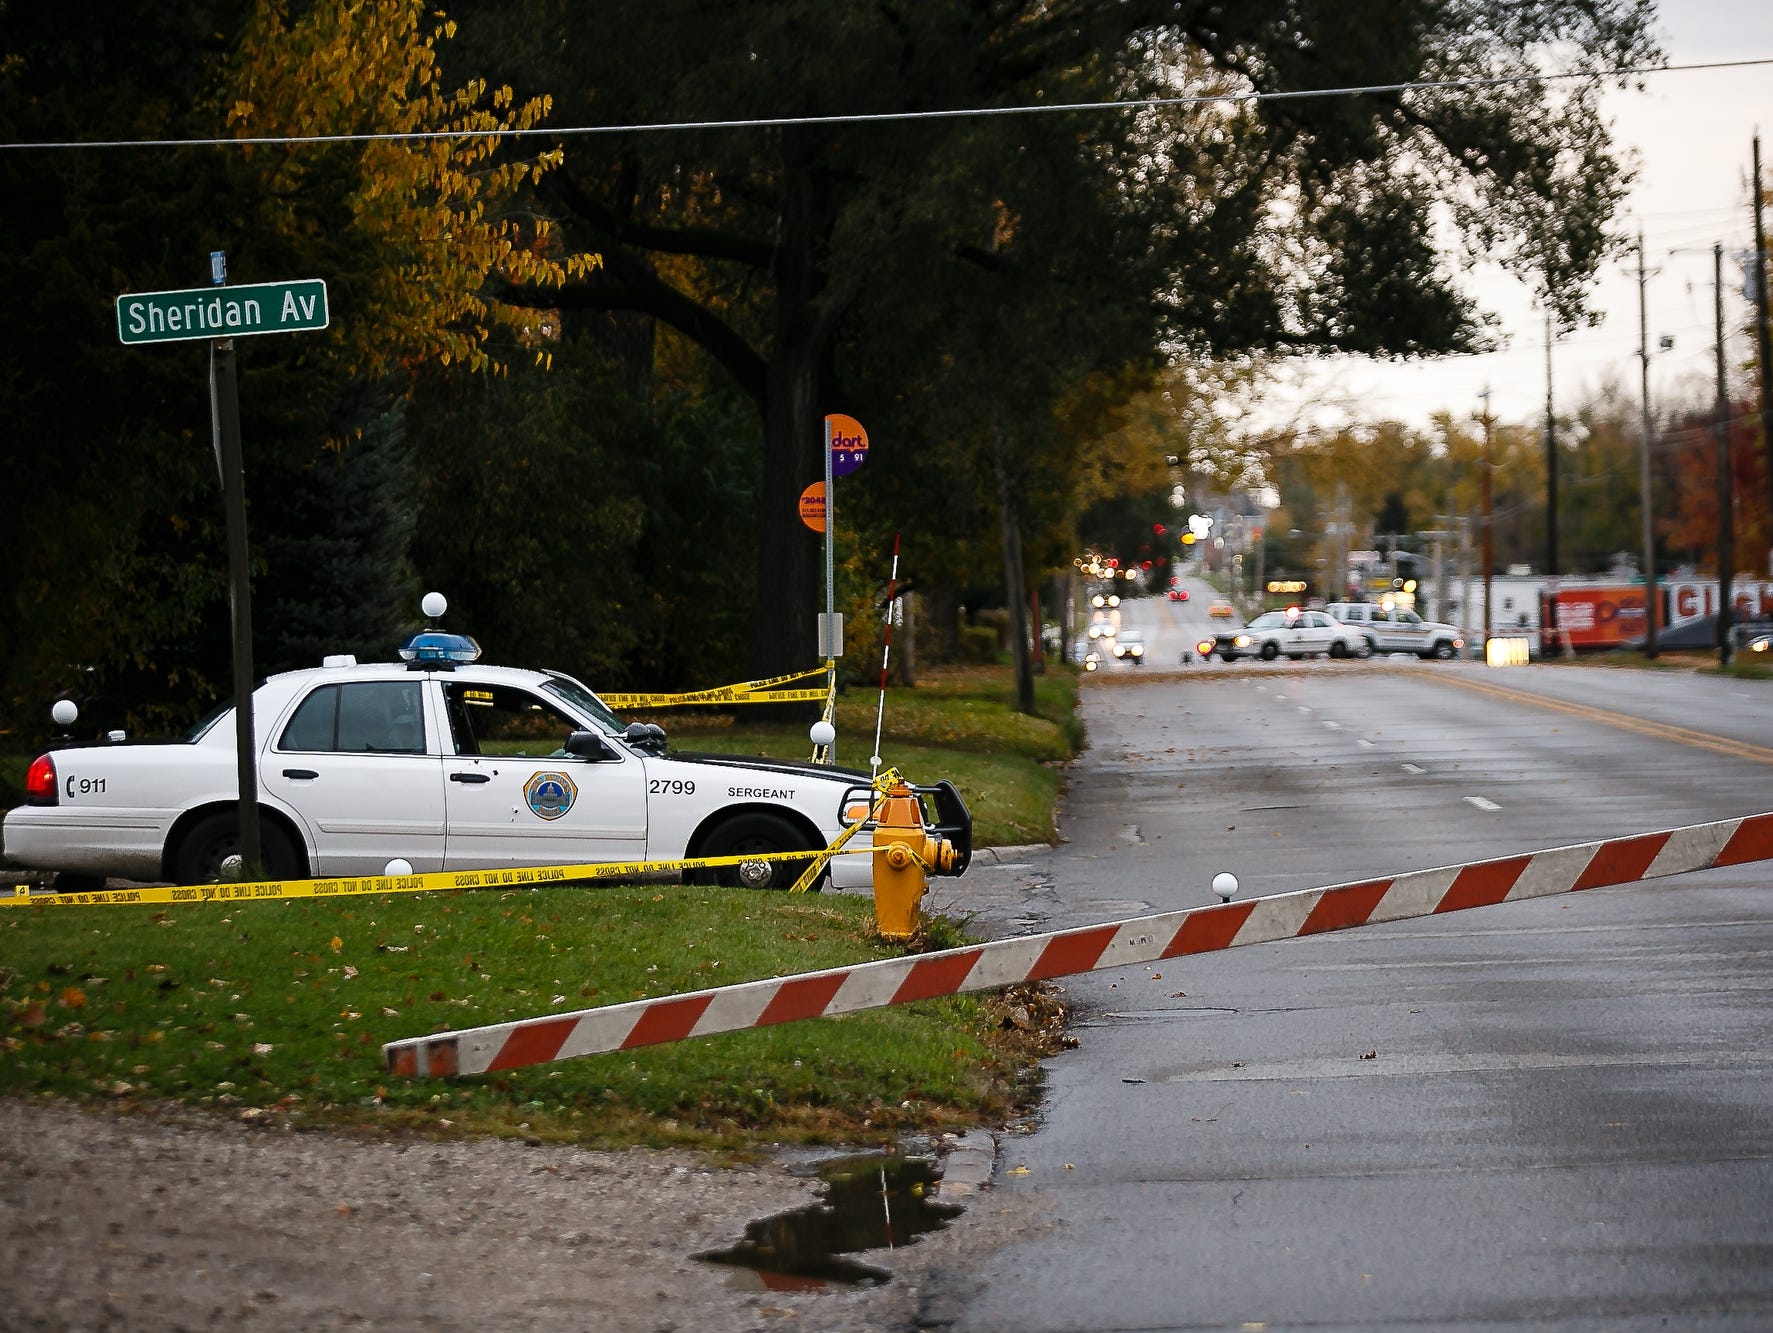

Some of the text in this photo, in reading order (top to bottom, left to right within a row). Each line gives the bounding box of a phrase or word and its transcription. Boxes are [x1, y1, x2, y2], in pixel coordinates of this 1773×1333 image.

[129, 290, 316, 333] Sheridan Av
[840, 453, 863, 461] 5 91
[80, 778, 106, 793] 911
[649, 779, 695, 795] 2799
[728, 787, 796, 799] SERGEANT
[19, 886, 26, 894] 4
